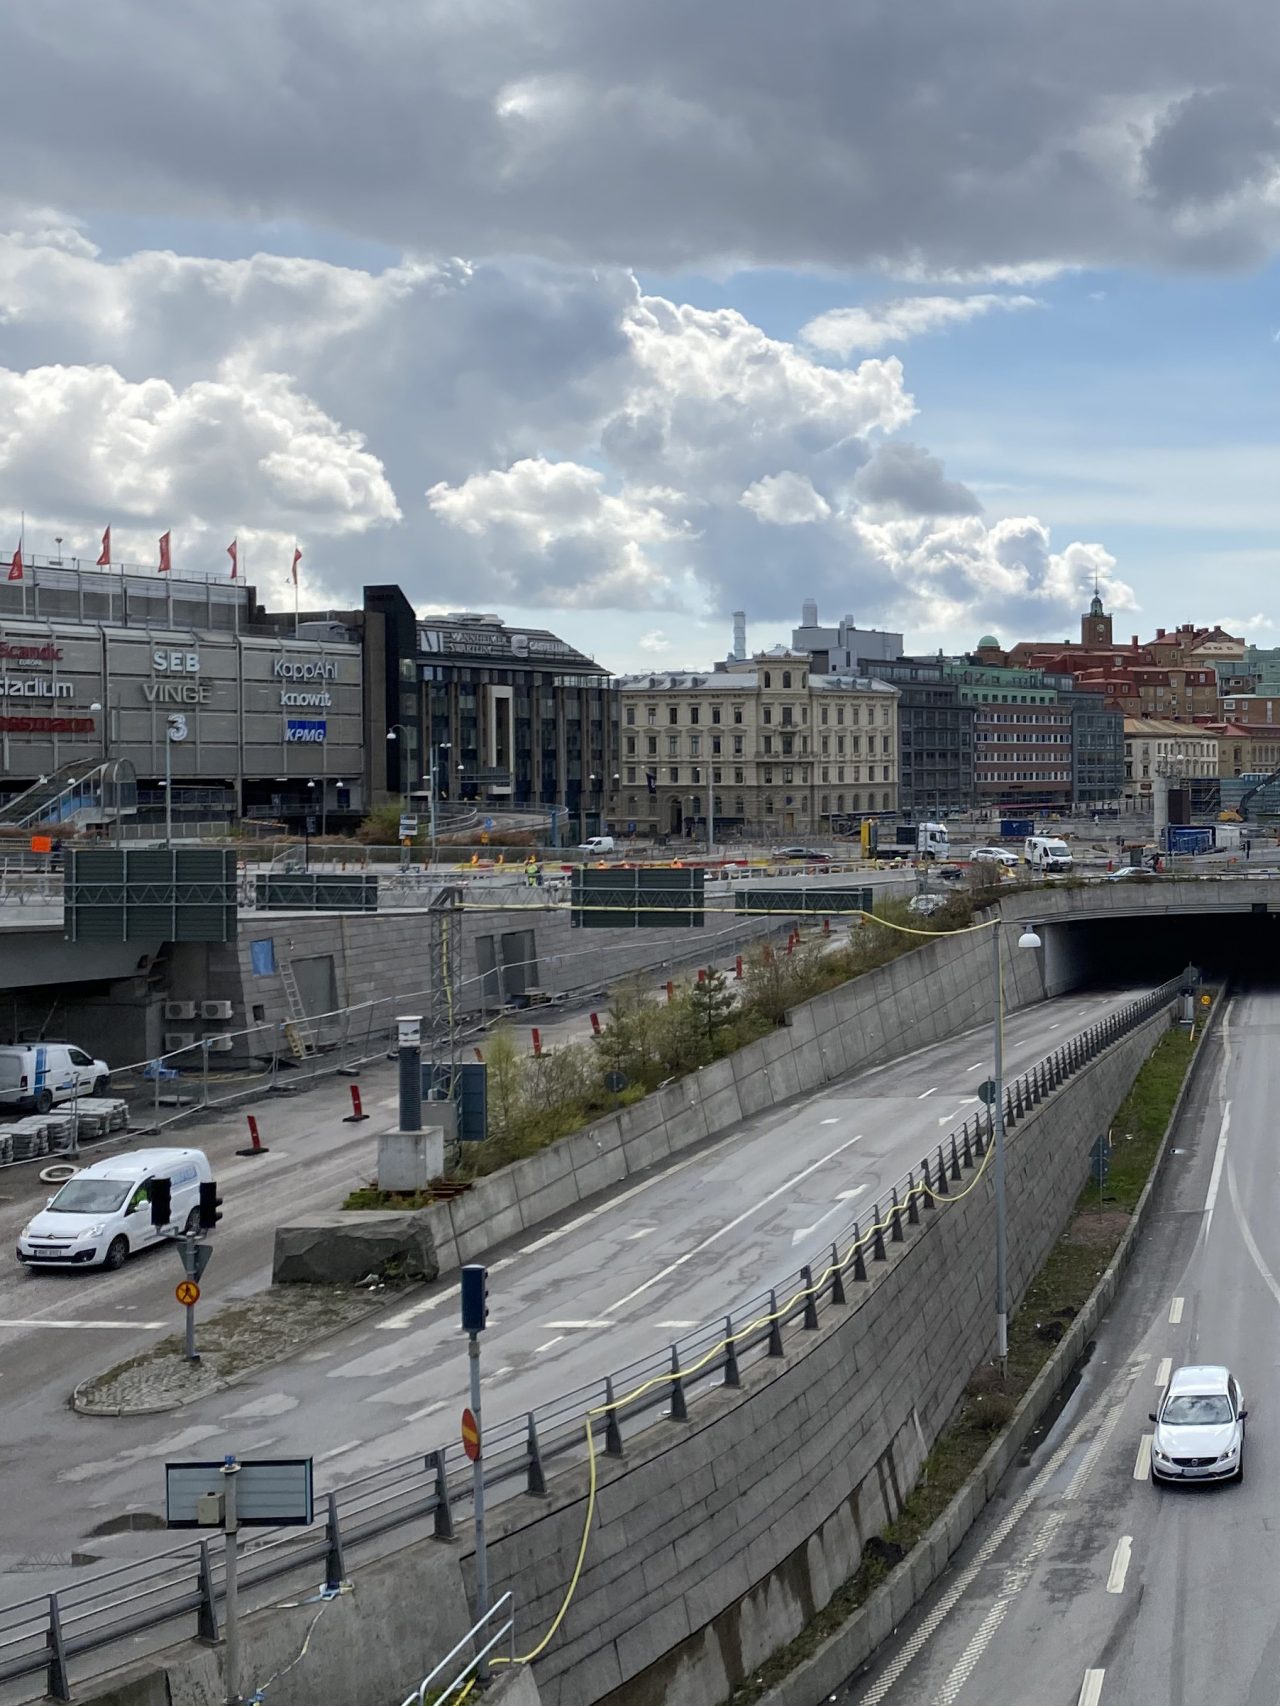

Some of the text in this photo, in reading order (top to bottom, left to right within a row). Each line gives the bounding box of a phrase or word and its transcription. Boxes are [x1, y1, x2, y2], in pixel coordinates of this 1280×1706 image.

[153, 651, 200, 672] SEB
[274, 659, 338, 681] KappAhl
[142, 684, 212, 704] VINGE
[280, 690, 332, 707] knowit
[167, 713, 188, 741] 3
[285, 728, 325, 742] KPMG
